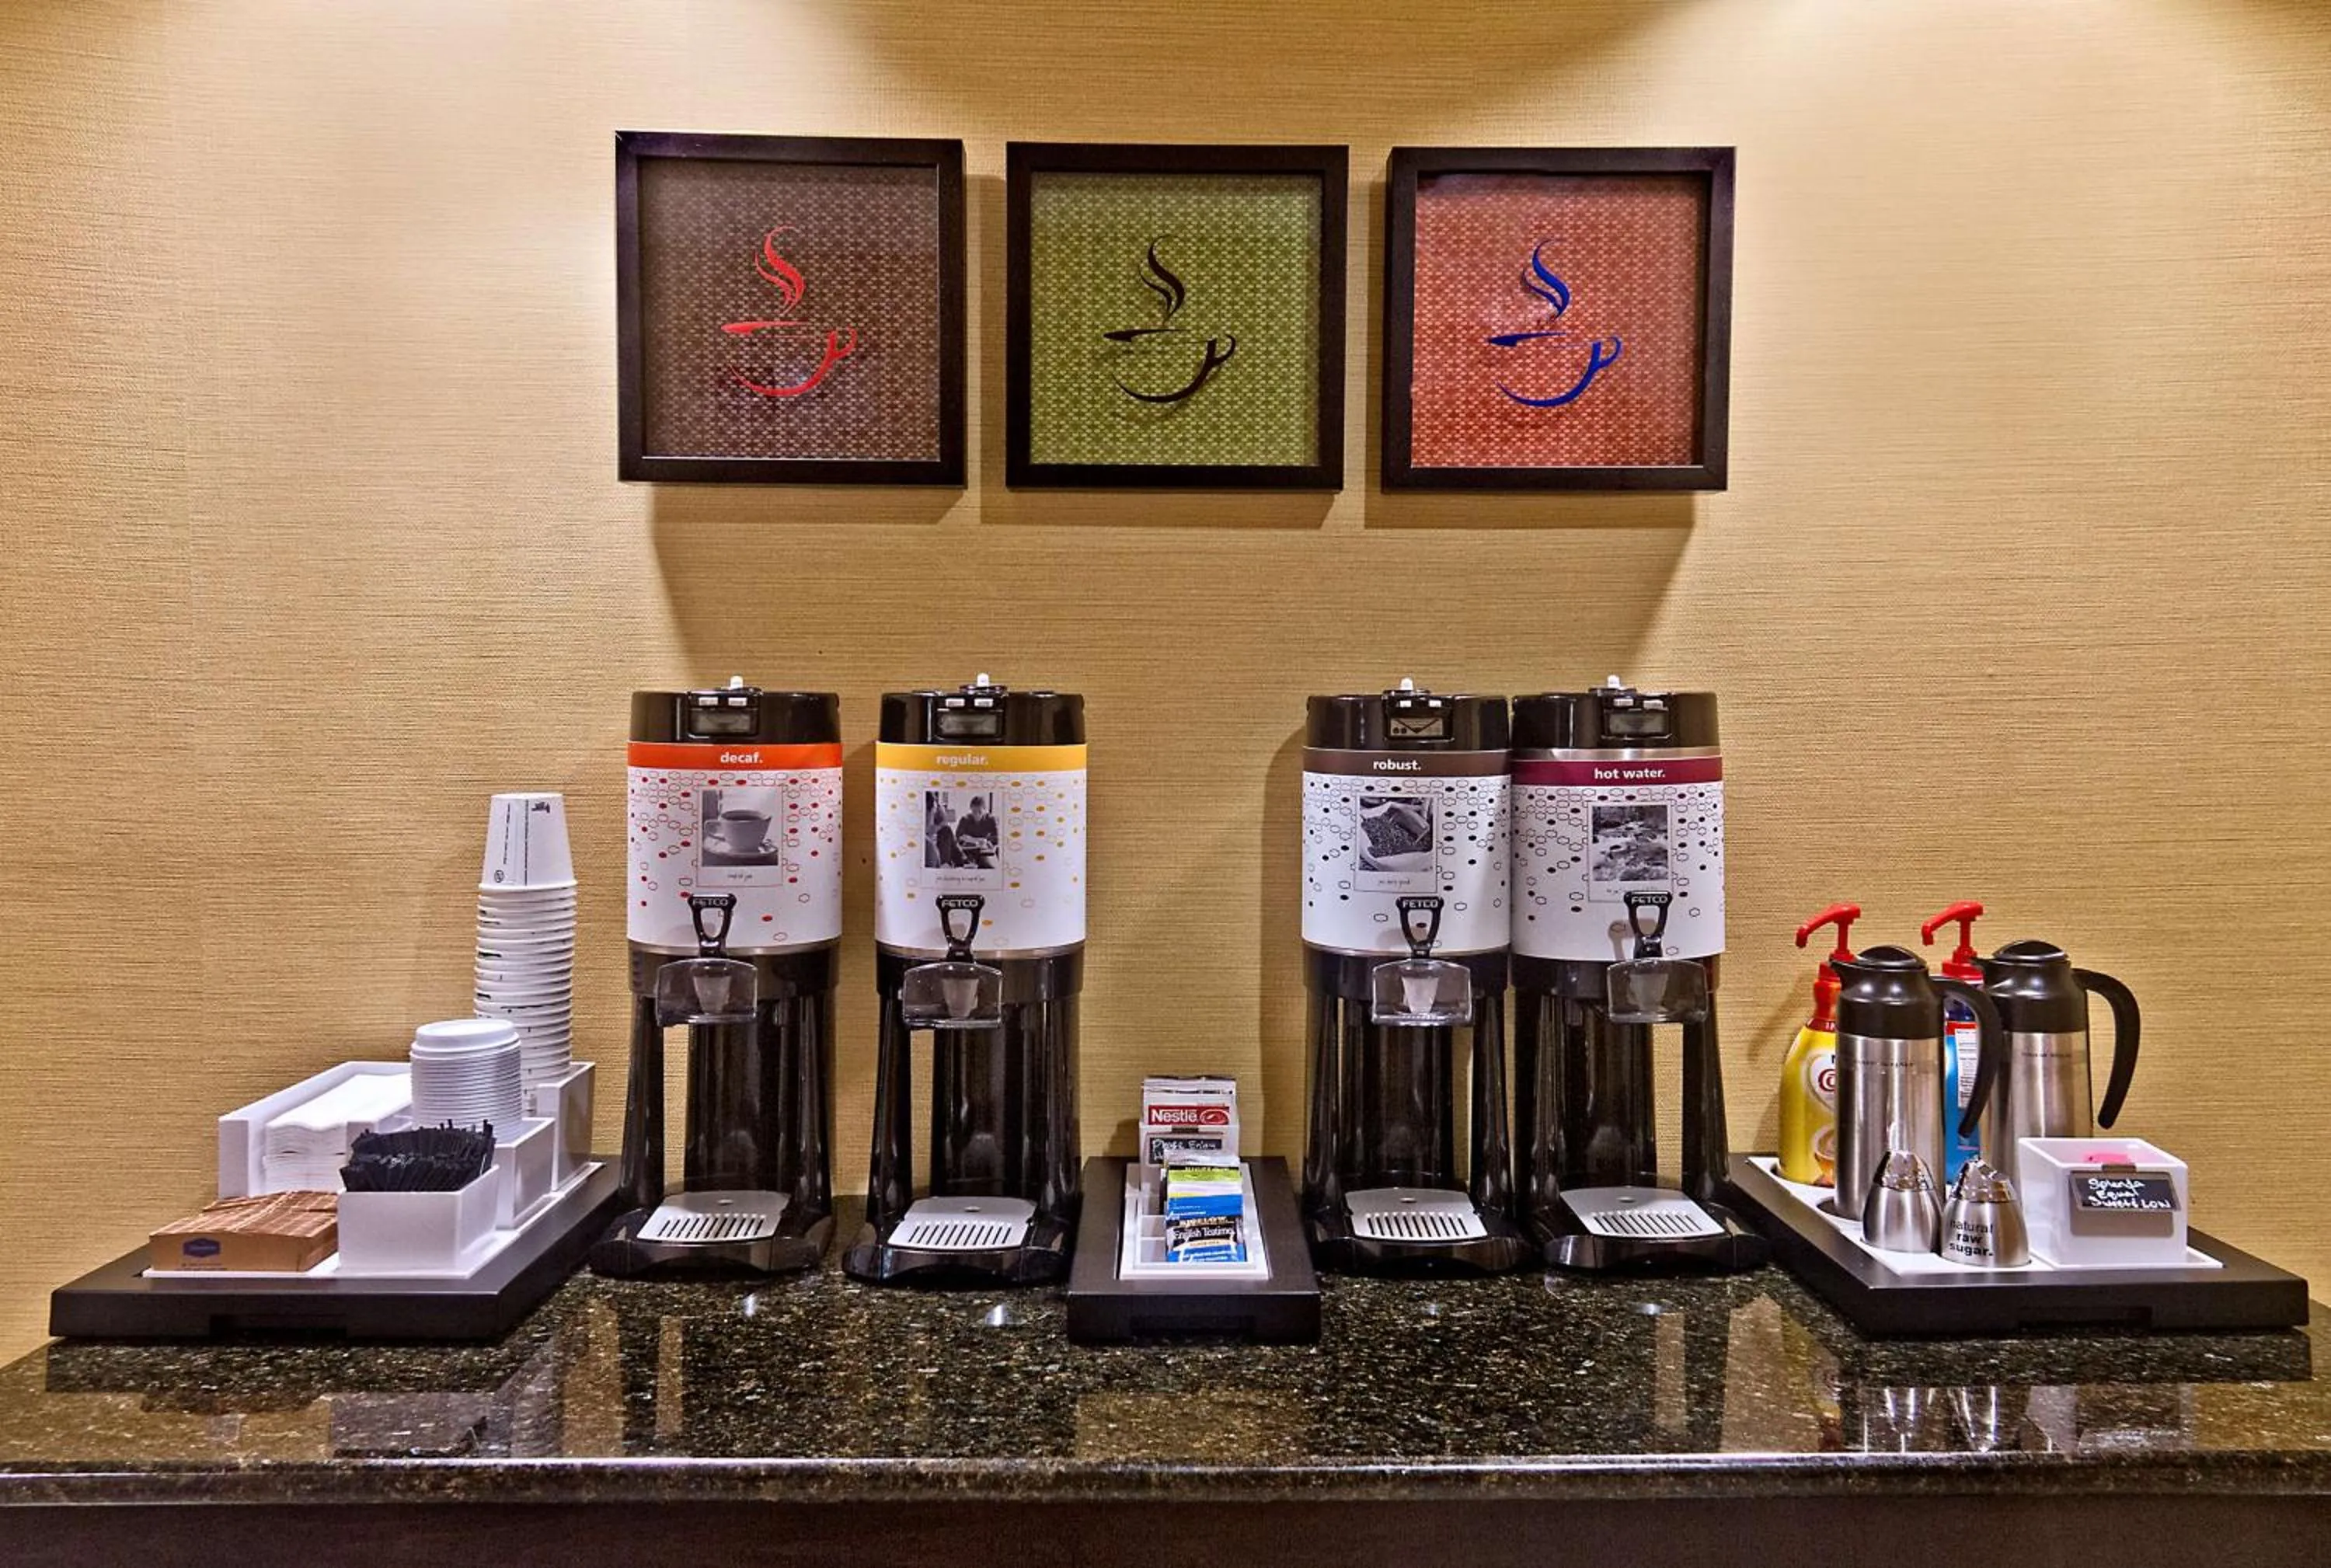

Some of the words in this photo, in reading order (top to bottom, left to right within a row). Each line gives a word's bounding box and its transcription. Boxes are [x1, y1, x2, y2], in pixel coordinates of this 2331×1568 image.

[720, 751, 764, 764] decaf.
[936, 753, 989, 768] regular.
[1373, 758, 1422, 771] robust.
[1594, 767, 1620, 779] hot
[1622, 768, 1666, 779] water.
[692, 898, 729, 907] FETCO
[941, 899, 978, 908] FETCO
[1402, 900, 1438, 908] FETCO
[1632, 895, 1668, 904] FETCO
[1950, 1220, 1993, 1234] natural
[1956, 1233, 1982, 1244] raw
[1949, 1242, 1993, 1256] sugar.
